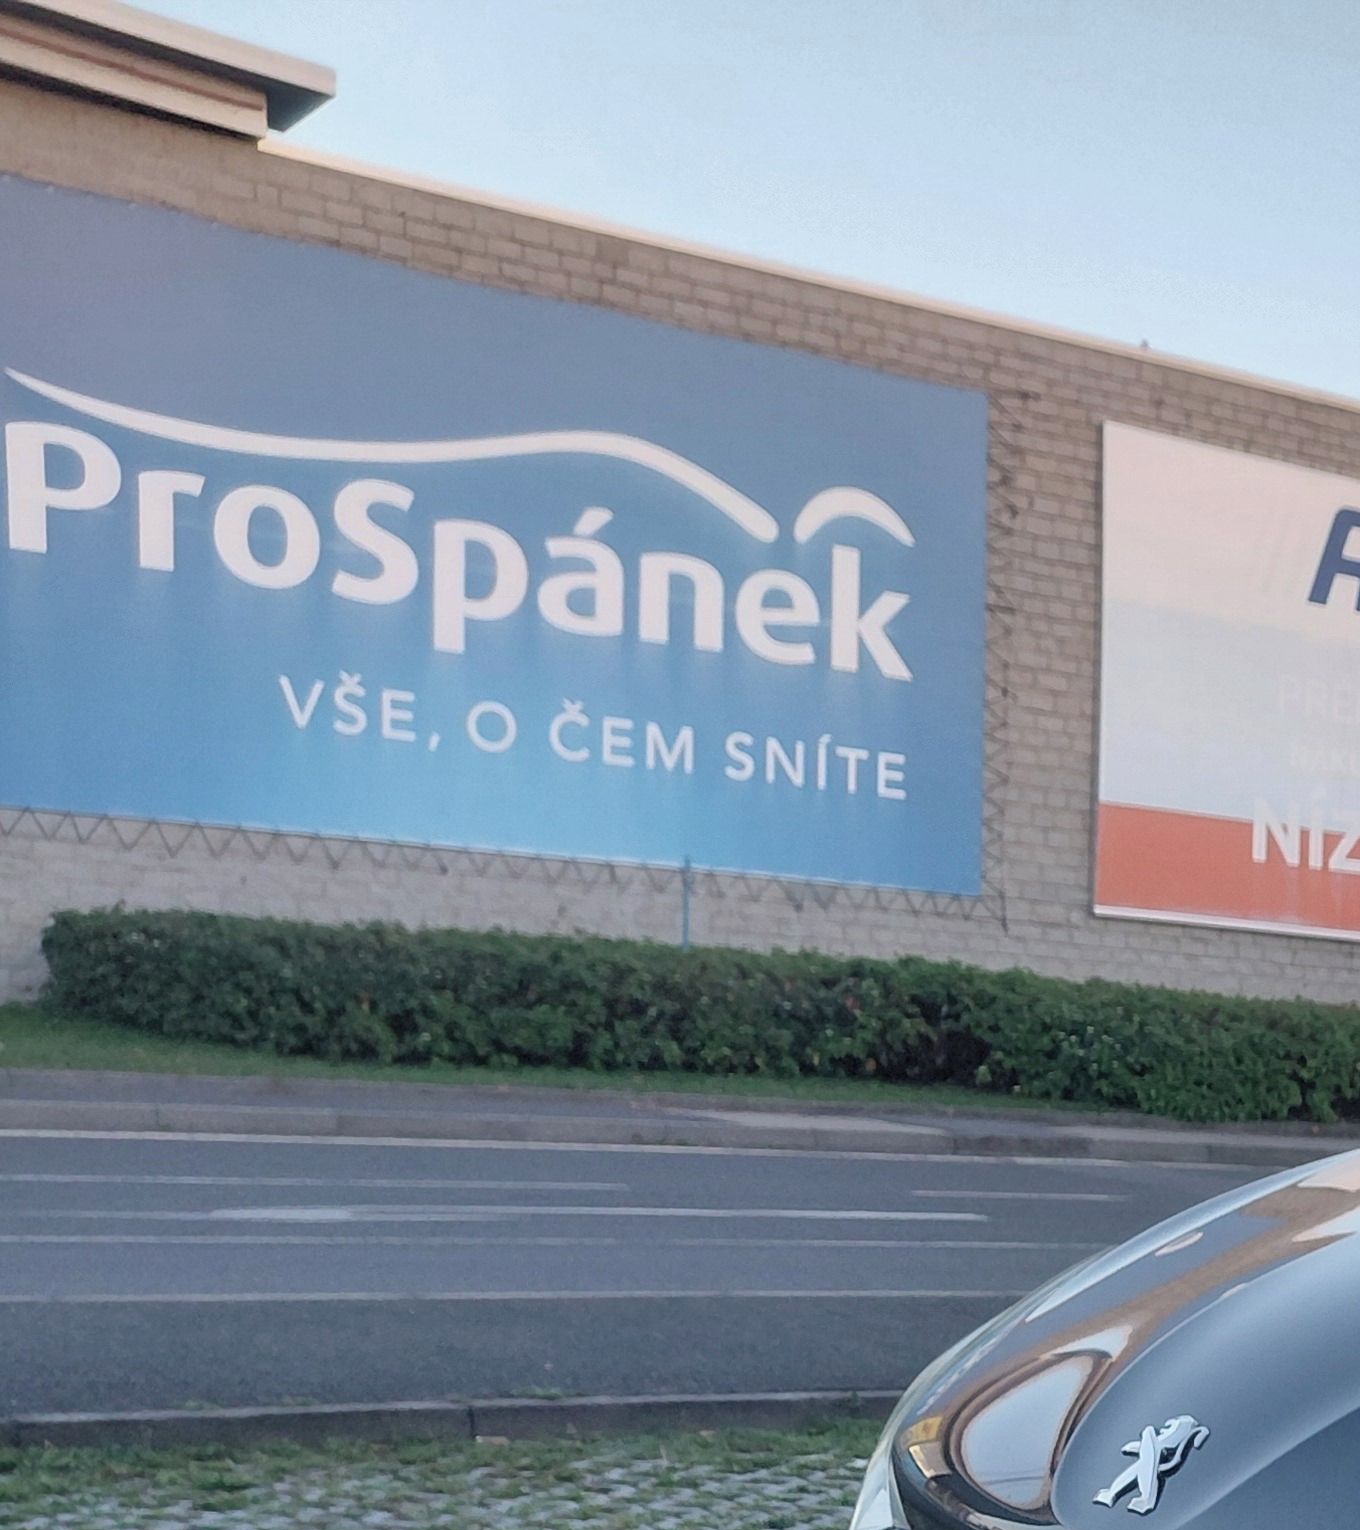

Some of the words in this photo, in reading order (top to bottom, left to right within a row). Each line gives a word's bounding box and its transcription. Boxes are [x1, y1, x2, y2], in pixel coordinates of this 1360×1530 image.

[4, 420, 914, 682] ProSpánek
[279, 671, 441, 752] VŠE,
[466, 701, 518, 754] O
[549, 698, 695, 774] ČEM
[724, 731, 908, 800] SNÍTE
